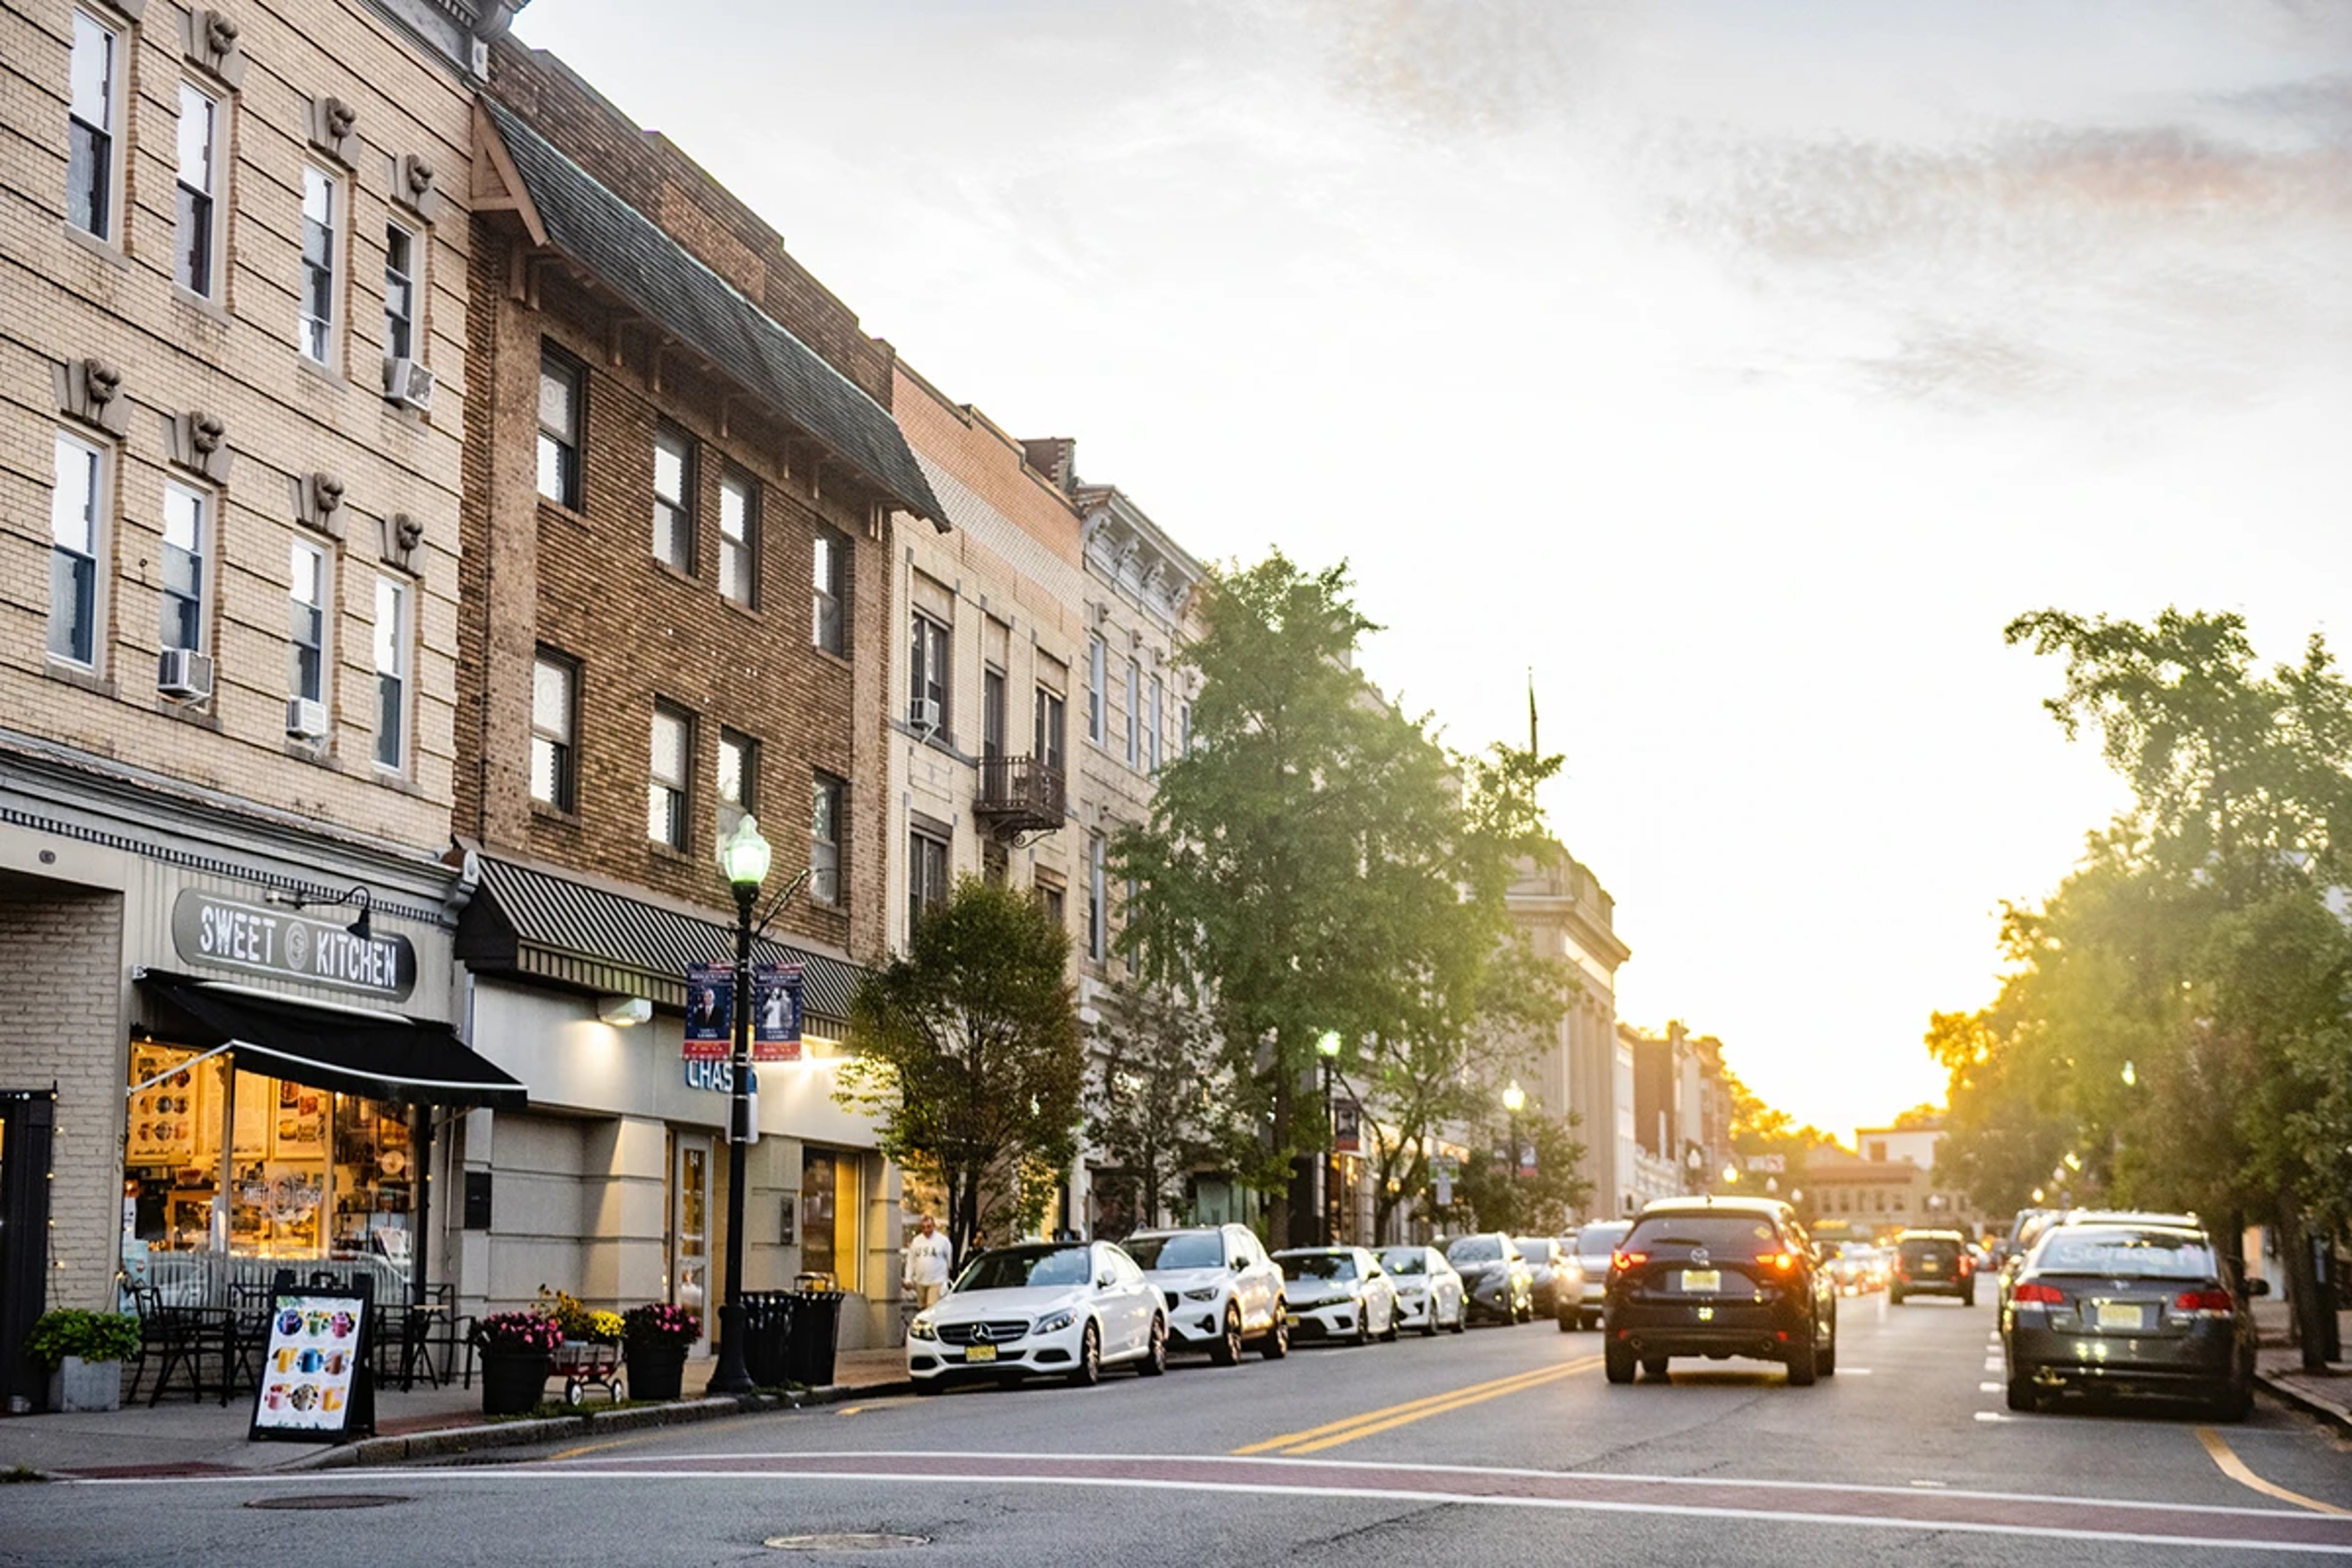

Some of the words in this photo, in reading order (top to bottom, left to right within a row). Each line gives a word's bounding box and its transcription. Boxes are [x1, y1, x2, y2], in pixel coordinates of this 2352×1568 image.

[200, 905, 277, 964] SWEET
[316, 930, 396, 988] KITCHEN
[688, 1060, 734, 1092] CHAS
[915, 1246, 938, 1257] USA
